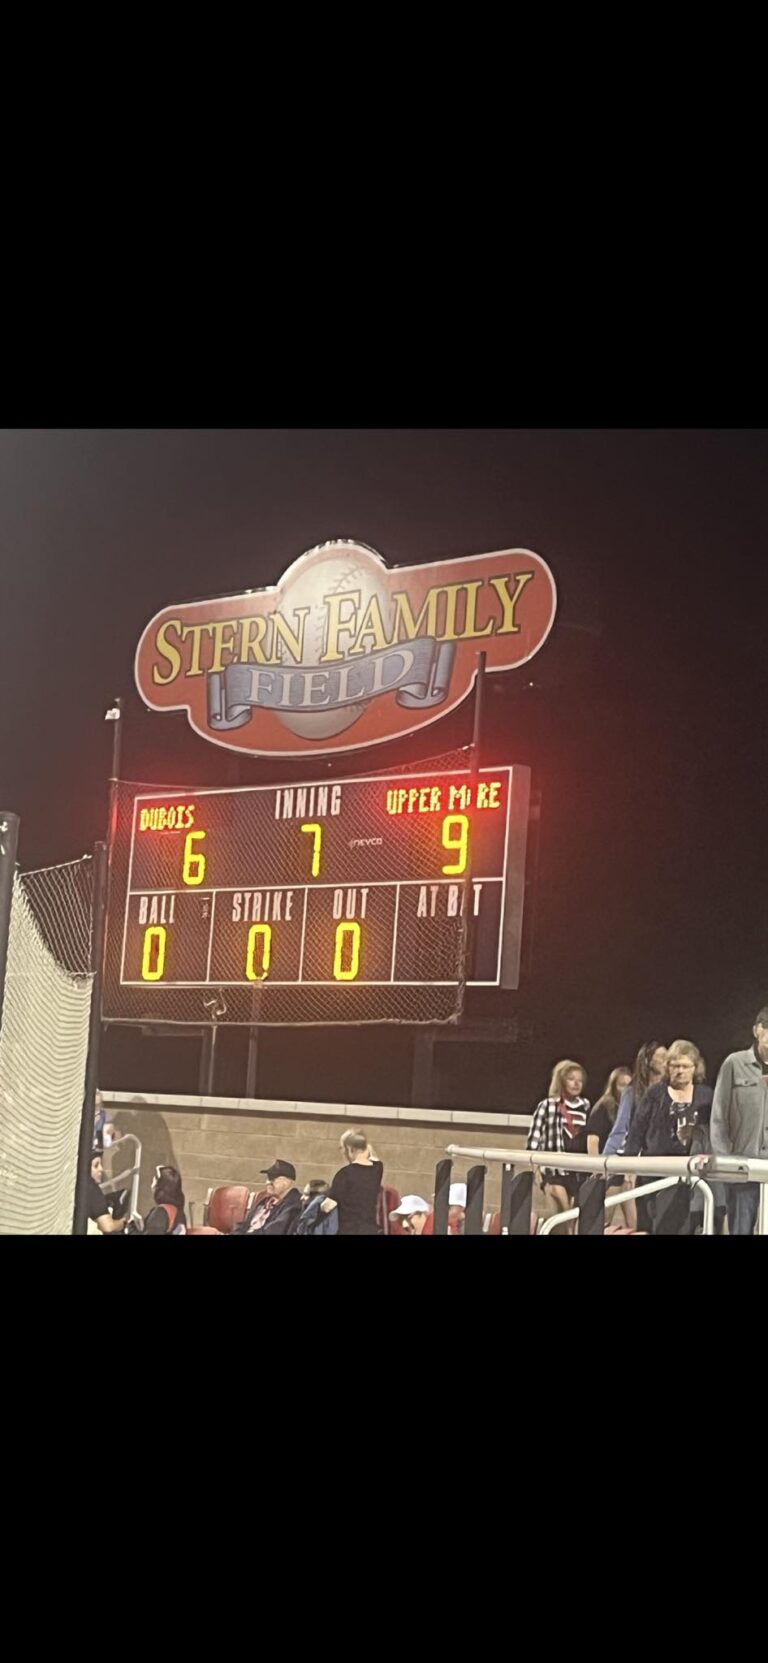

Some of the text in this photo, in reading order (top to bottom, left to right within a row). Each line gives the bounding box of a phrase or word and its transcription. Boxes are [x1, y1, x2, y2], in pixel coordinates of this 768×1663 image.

[152, 572, 535, 686] STERN FAMILY
[246, 648, 415, 707] FIELD
[140, 804, 195, 831] DUBOIS
[275, 785, 342, 819] INNING
[386, 786, 441, 815] UPPER
[182, 830, 206, 885] 6
[301, 823, 321, 877] 7
[441, 814, 469, 875] 9
[139, 895, 176, 924] BALL
[232, 891, 294, 922] STRIKE
[333, 888, 369, 919] OUT
[417, 885, 440, 917] AT
[142, 926, 166, 981] 0
[246, 924, 271, 981] 0
[333, 922, 361, 981] 0
